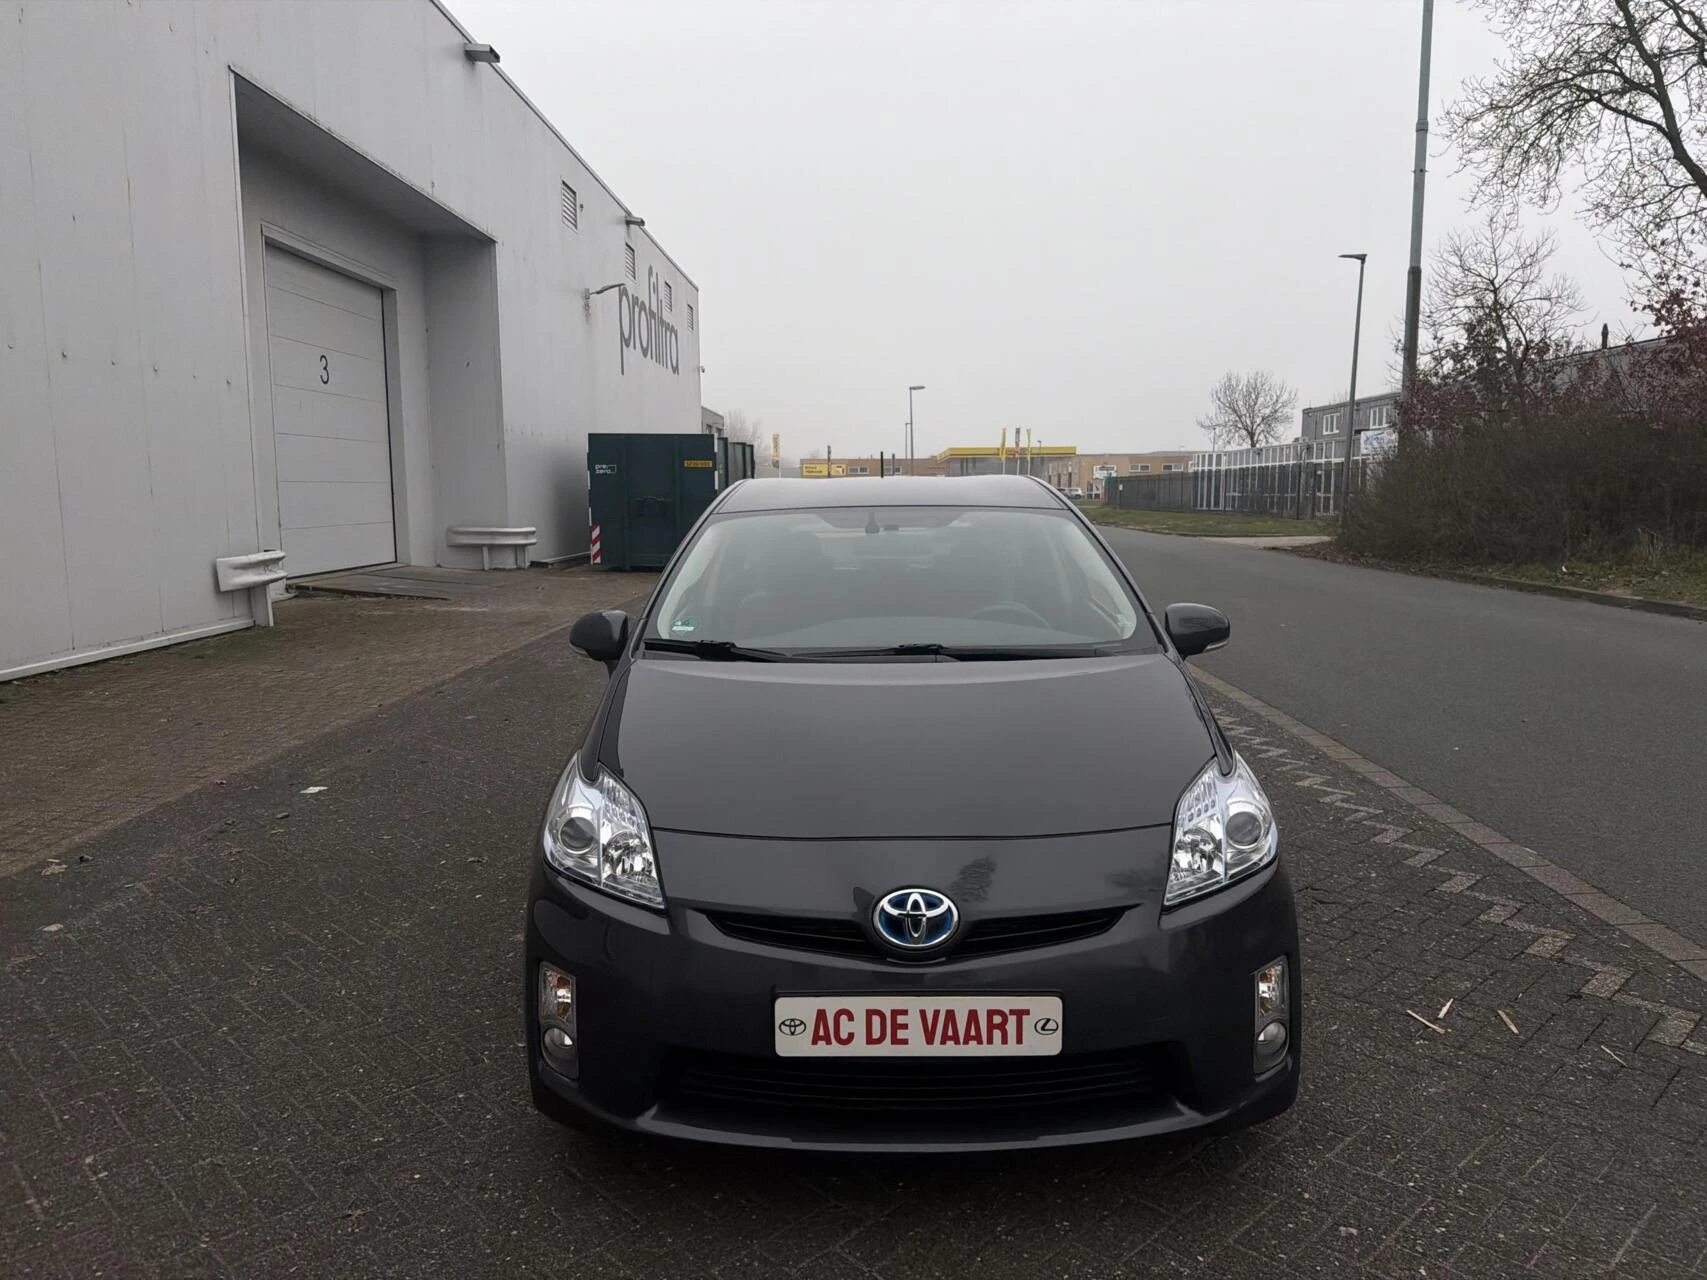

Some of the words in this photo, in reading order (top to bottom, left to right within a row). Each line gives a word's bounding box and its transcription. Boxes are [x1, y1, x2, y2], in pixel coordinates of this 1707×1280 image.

[618, 265, 680, 376] profiltra
[319, 354, 330, 385] 3
[811, 1008, 855, 1046] AC
[865, 1008, 909, 1046] DE
[919, 1008, 1031, 1046] VAART
